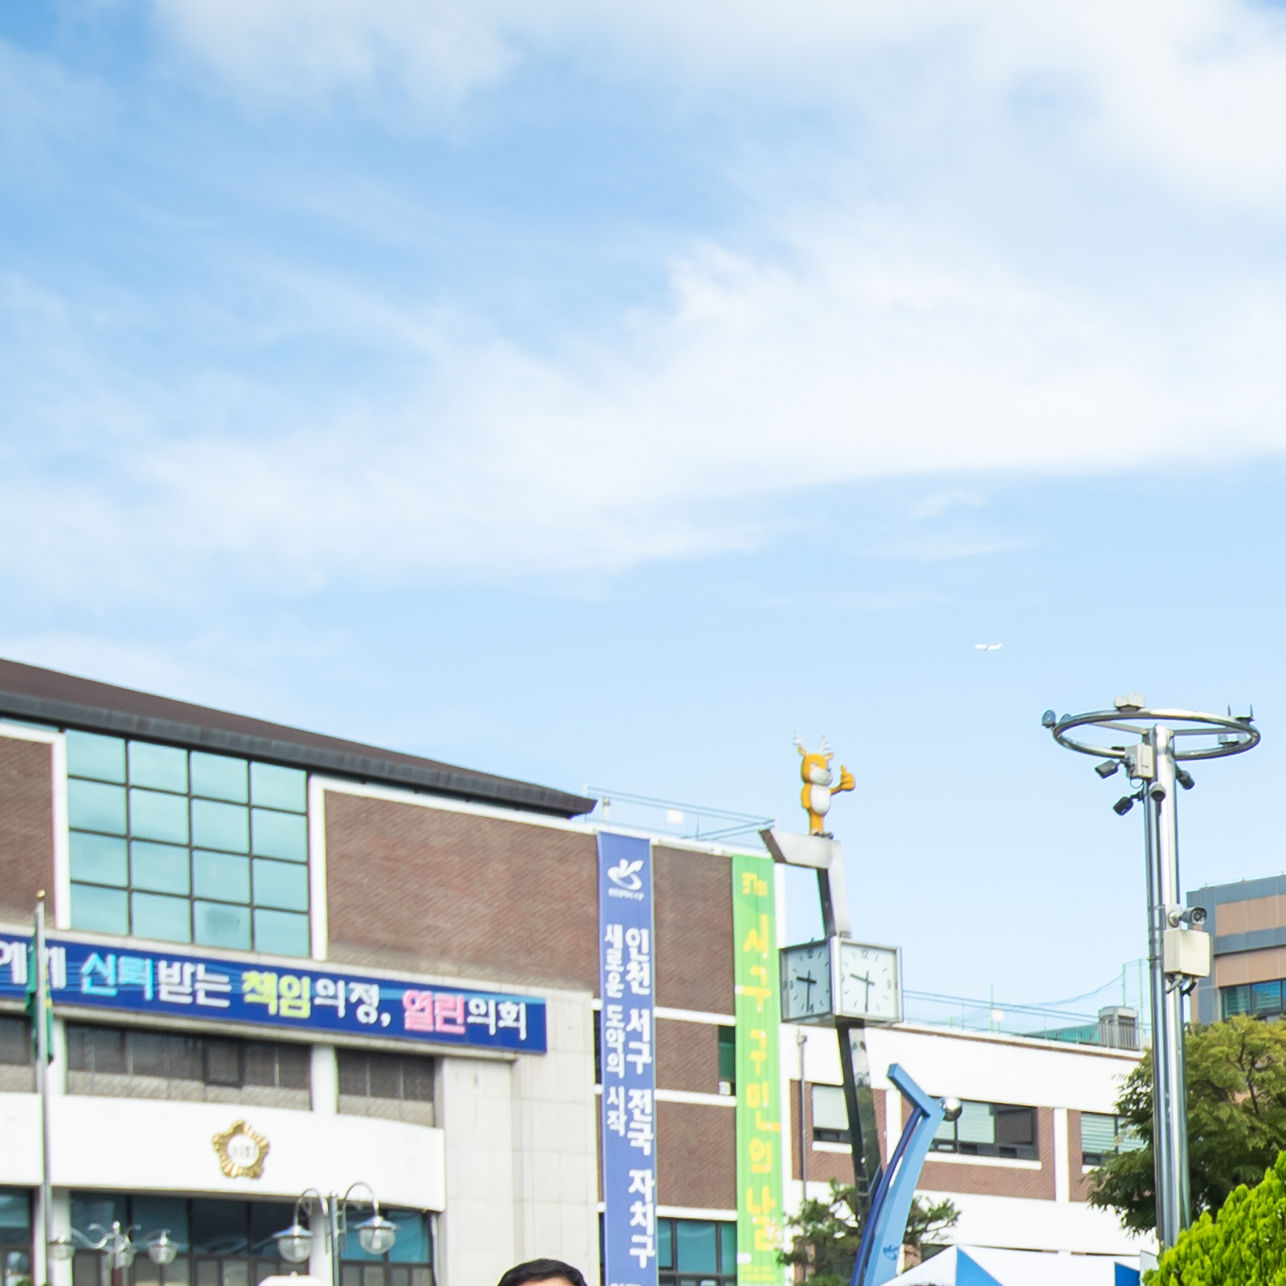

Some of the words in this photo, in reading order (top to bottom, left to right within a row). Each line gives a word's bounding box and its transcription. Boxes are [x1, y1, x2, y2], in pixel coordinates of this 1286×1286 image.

[81, 952, 232, 1007] 신뢰받는
[402, 988, 527, 1040] 열린의회
[604, 924, 624, 999] 새로운
[625, 928, 650, 996] 인천
[606, 1005, 625, 1078] 도약의
[626, 1008, 652, 1075] 서구
[606, 1086, 627, 1137] 시작
[628, 1089, 654, 1156] 전국
[628, 1169, 656, 1268] 자치구
